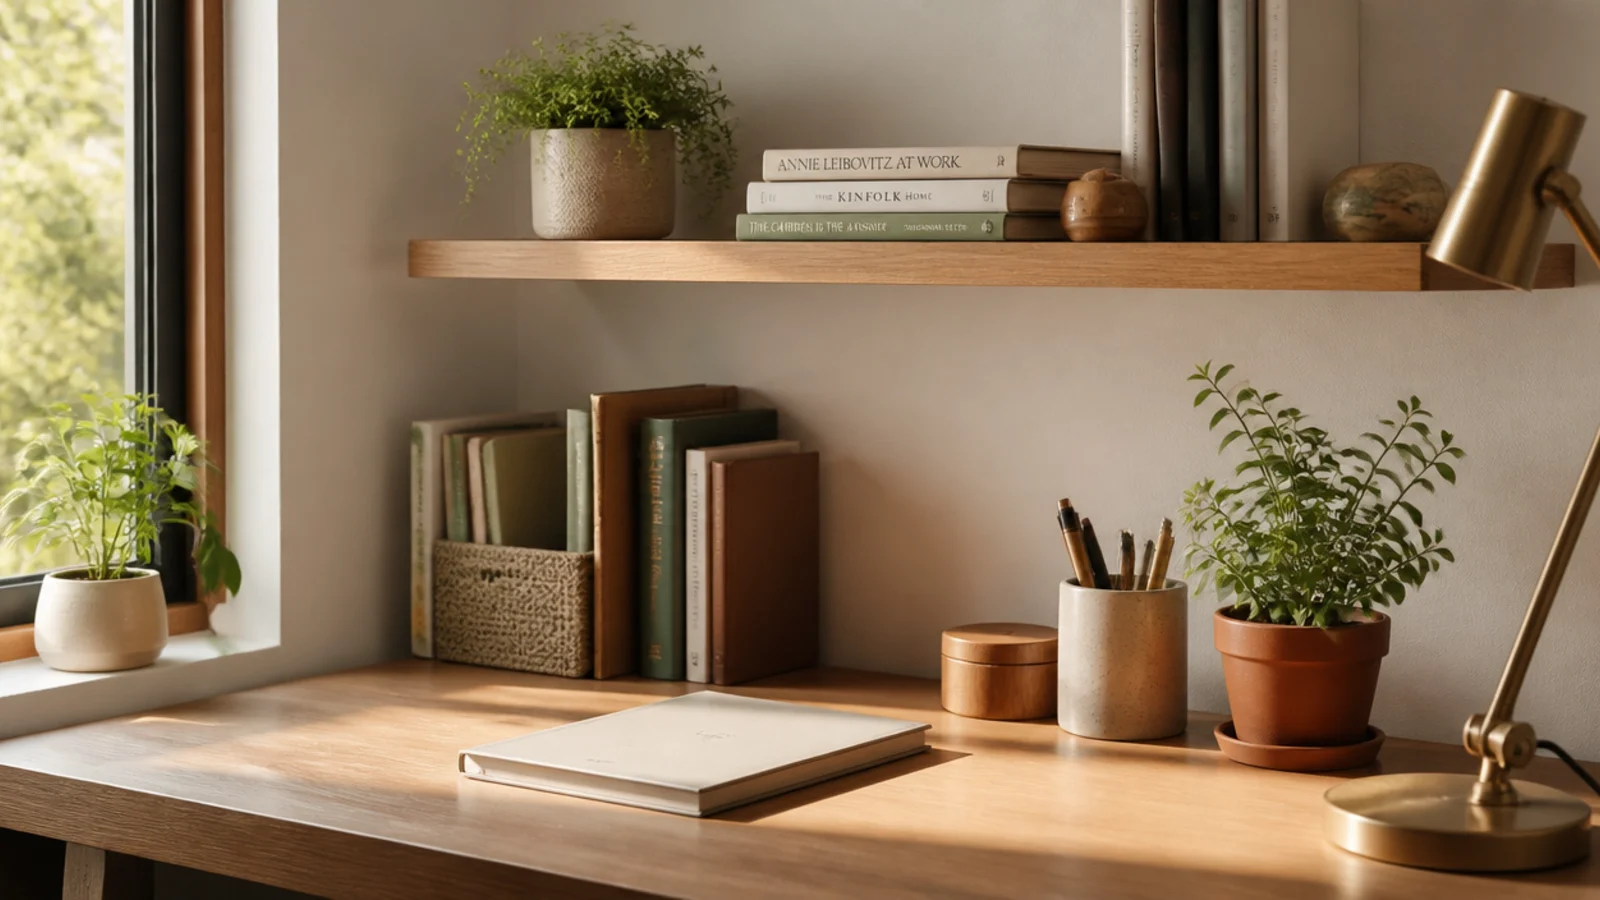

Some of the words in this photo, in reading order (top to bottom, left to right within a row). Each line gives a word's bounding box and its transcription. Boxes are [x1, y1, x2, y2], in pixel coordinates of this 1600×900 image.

[777, 157, 821, 172] ANNIE
[823, 156, 893, 171] LEIBOVITZ
[896, 155, 916, 170] AT
[917, 155, 962, 169] WORK
[837, 191, 902, 203] KINFOLK
